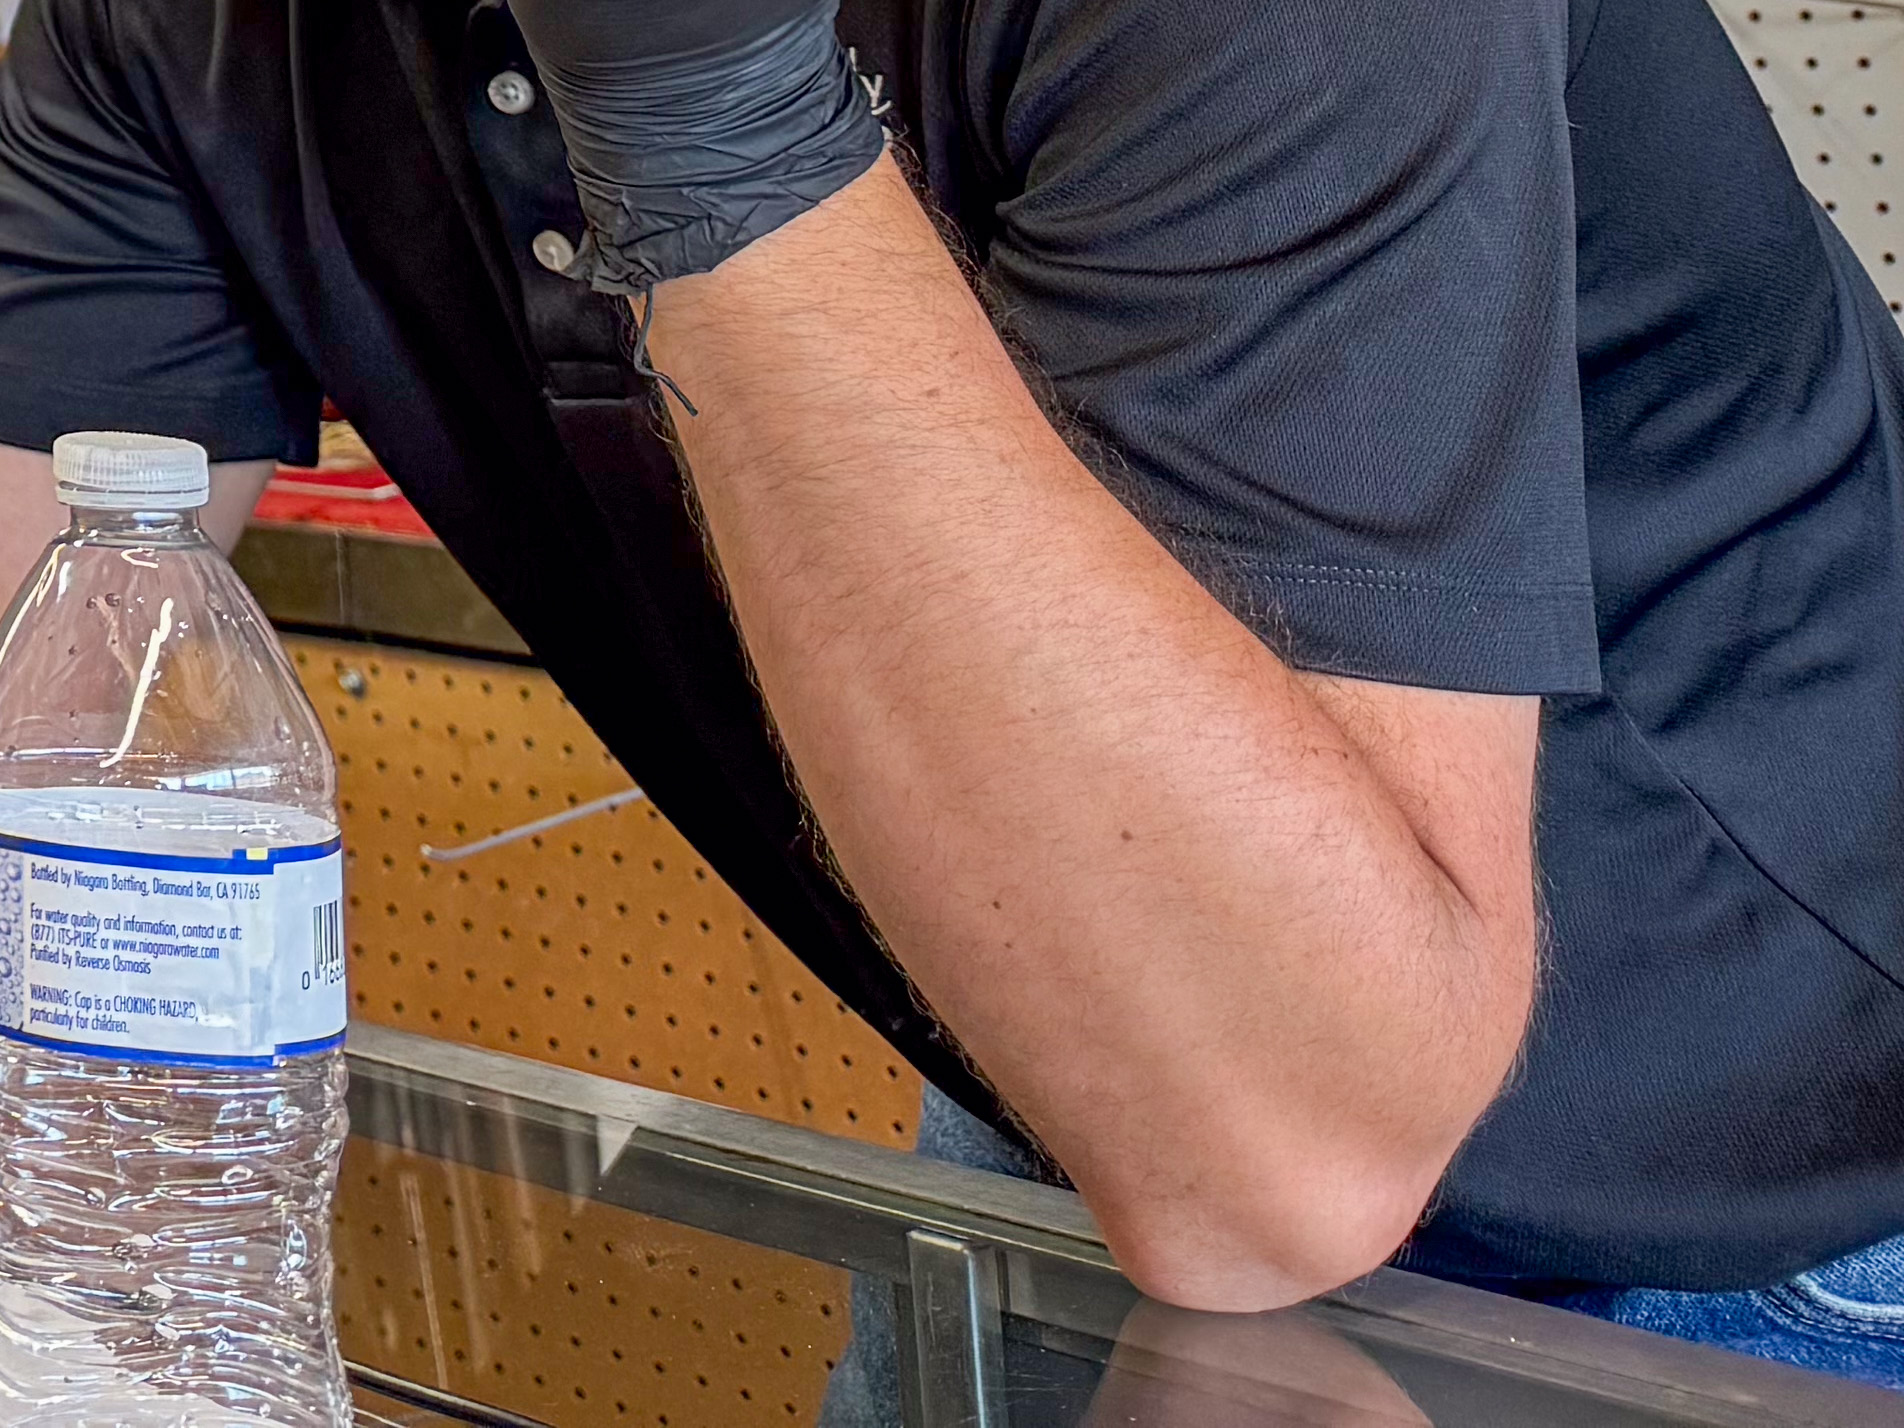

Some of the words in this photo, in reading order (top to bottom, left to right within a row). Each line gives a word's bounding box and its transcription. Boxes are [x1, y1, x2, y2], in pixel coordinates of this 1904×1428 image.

[31, 862, 58, 883] Bottled
[61, 873, 72, 887] by
[74, 870, 108, 891] Niagara
[112, 874, 149, 896] Bottling,
[153, 878, 193, 897] Diamond
[196, 881, 213, 901] Bar,
[216, 882, 228, 899] CA
[231, 882, 261, 900] 91765
[30, 903, 43, 919] For
[45, 908, 68, 924] water
[71, 910, 100, 932] quality
[104, 913, 121, 930] and
[124, 916, 179, 939] information,
[182, 925, 215, 940] contact
[217, 927, 227, 940] us
[230, 926, 242, 941] at:
[31, 923, 55, 944] (877)
[57, 927, 97, 949] ITS-PURE
[100, 938, 109, 950] or
[113, 938, 220, 960] www.niagarawater.com
[30, 943, 59, 964] Purified
[62, 952, 73, 969] by
[75, 951, 110, 970] Reverse
[113, 955, 151, 974] Osmosis
[301, 970, 311, 990] 0
[30, 983, 72, 1007] WARNING:
[75, 990, 92, 1011] Cap
[94, 994, 102, 1009] is
[104, 999, 111, 1011] a
[113, 995, 156, 1015] CHOKING
[30, 1007, 73, 1030] particularly
[76, 1013, 89, 1029] for
[91, 1013, 130, 1034] children.
